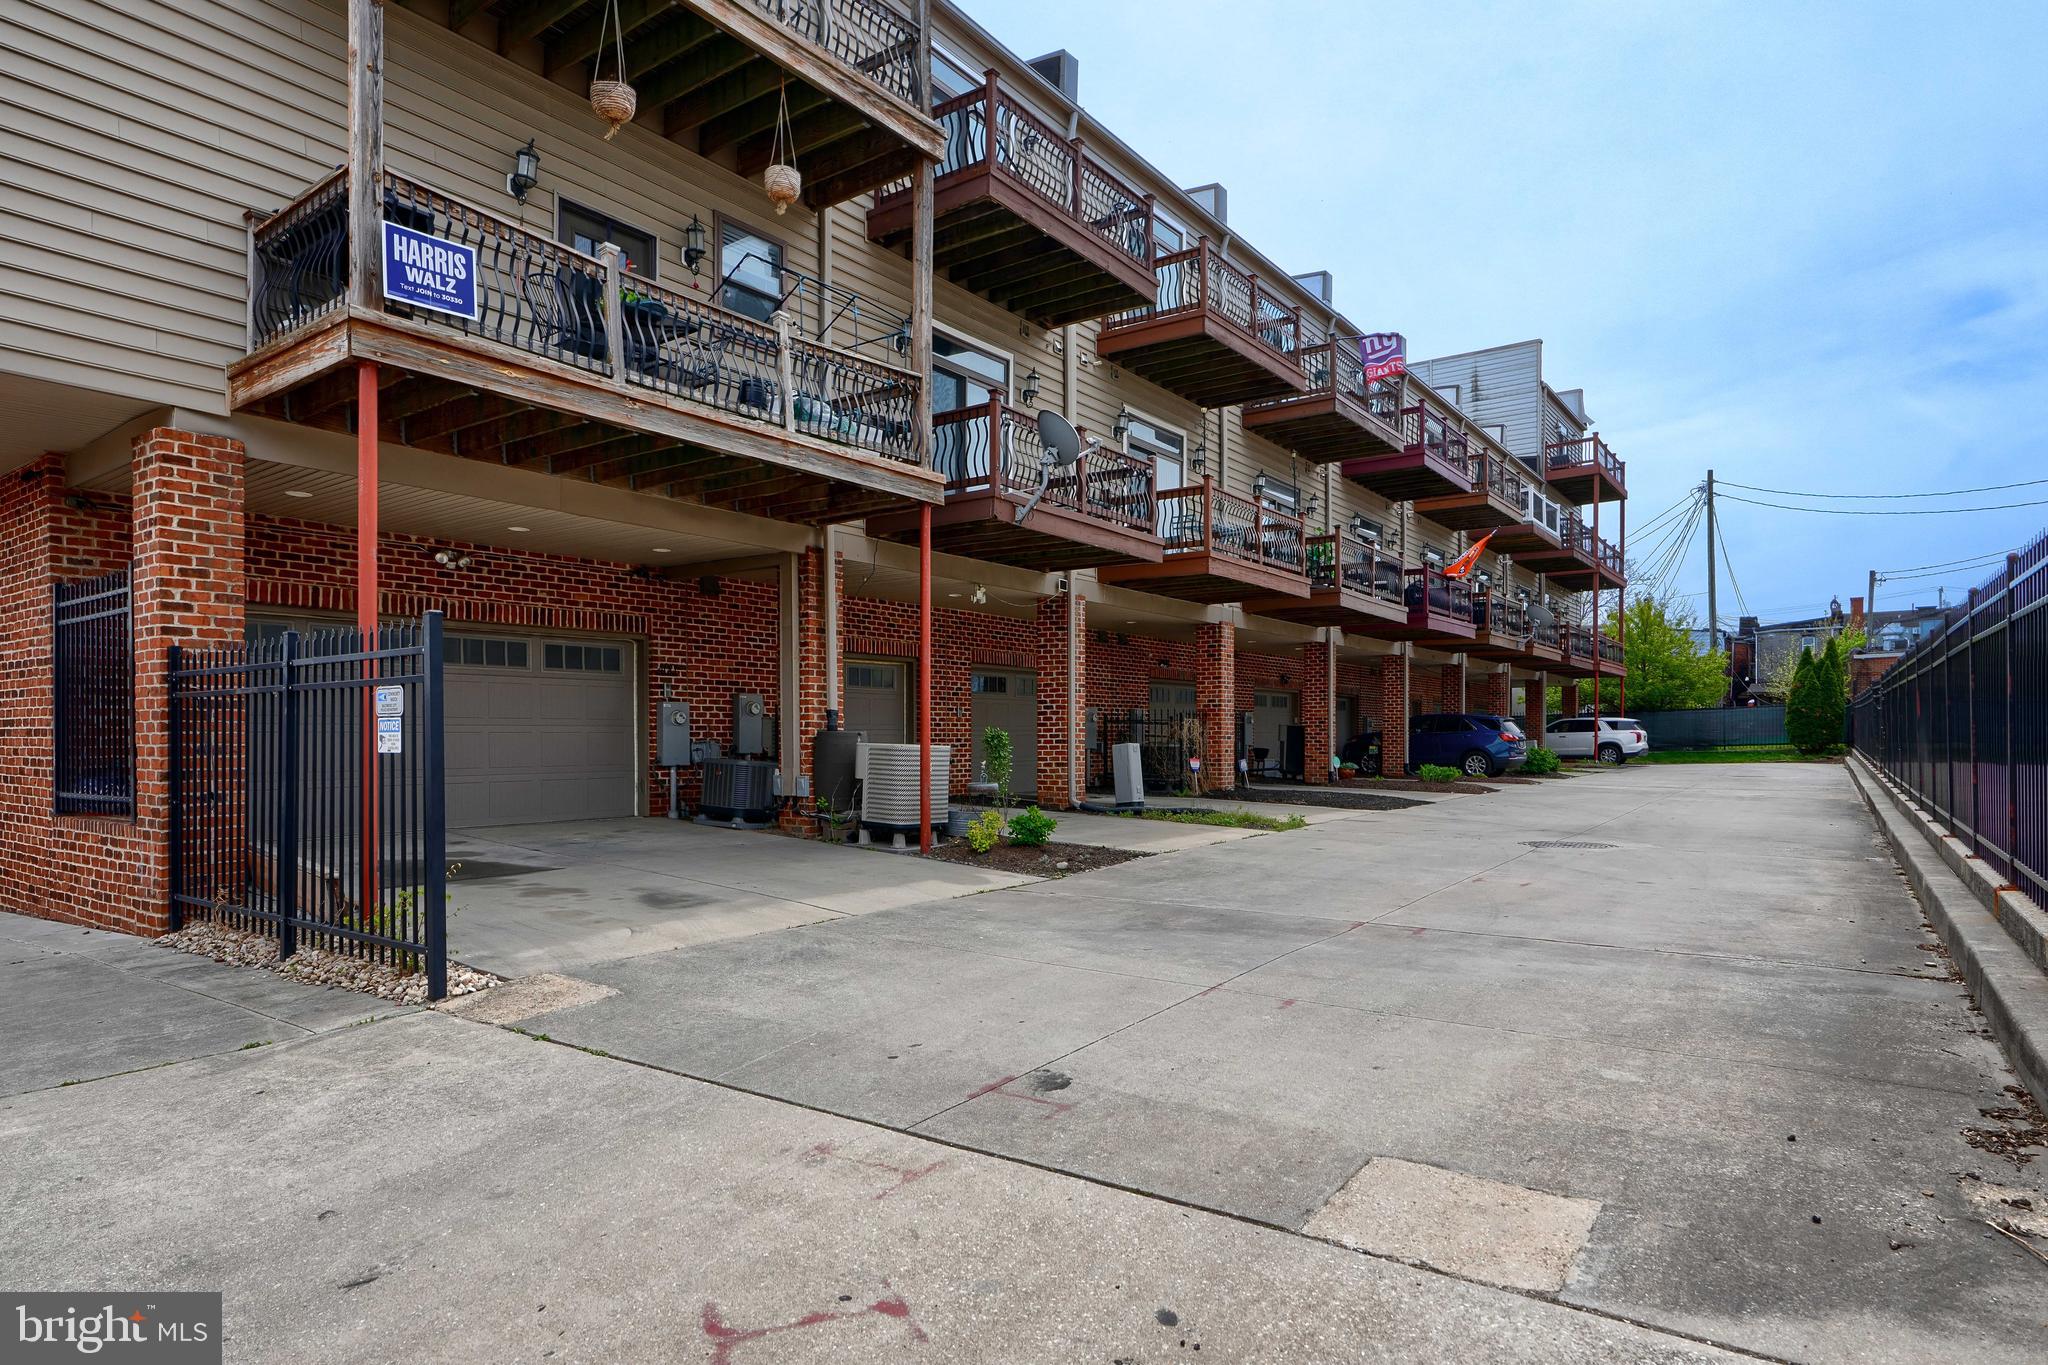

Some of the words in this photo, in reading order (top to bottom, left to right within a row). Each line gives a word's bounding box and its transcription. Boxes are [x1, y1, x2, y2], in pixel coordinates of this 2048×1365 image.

[393, 233, 466, 279] HARRIS
[405, 265, 456, 294] WALZ
[400, 282, 415, 292] Text
[416, 287, 433, 297] JOIN
[441, 294, 463, 305] 30330
[1366, 360, 1405, 378] GIANTS
[380, 720, 400, 732] NOTICE
